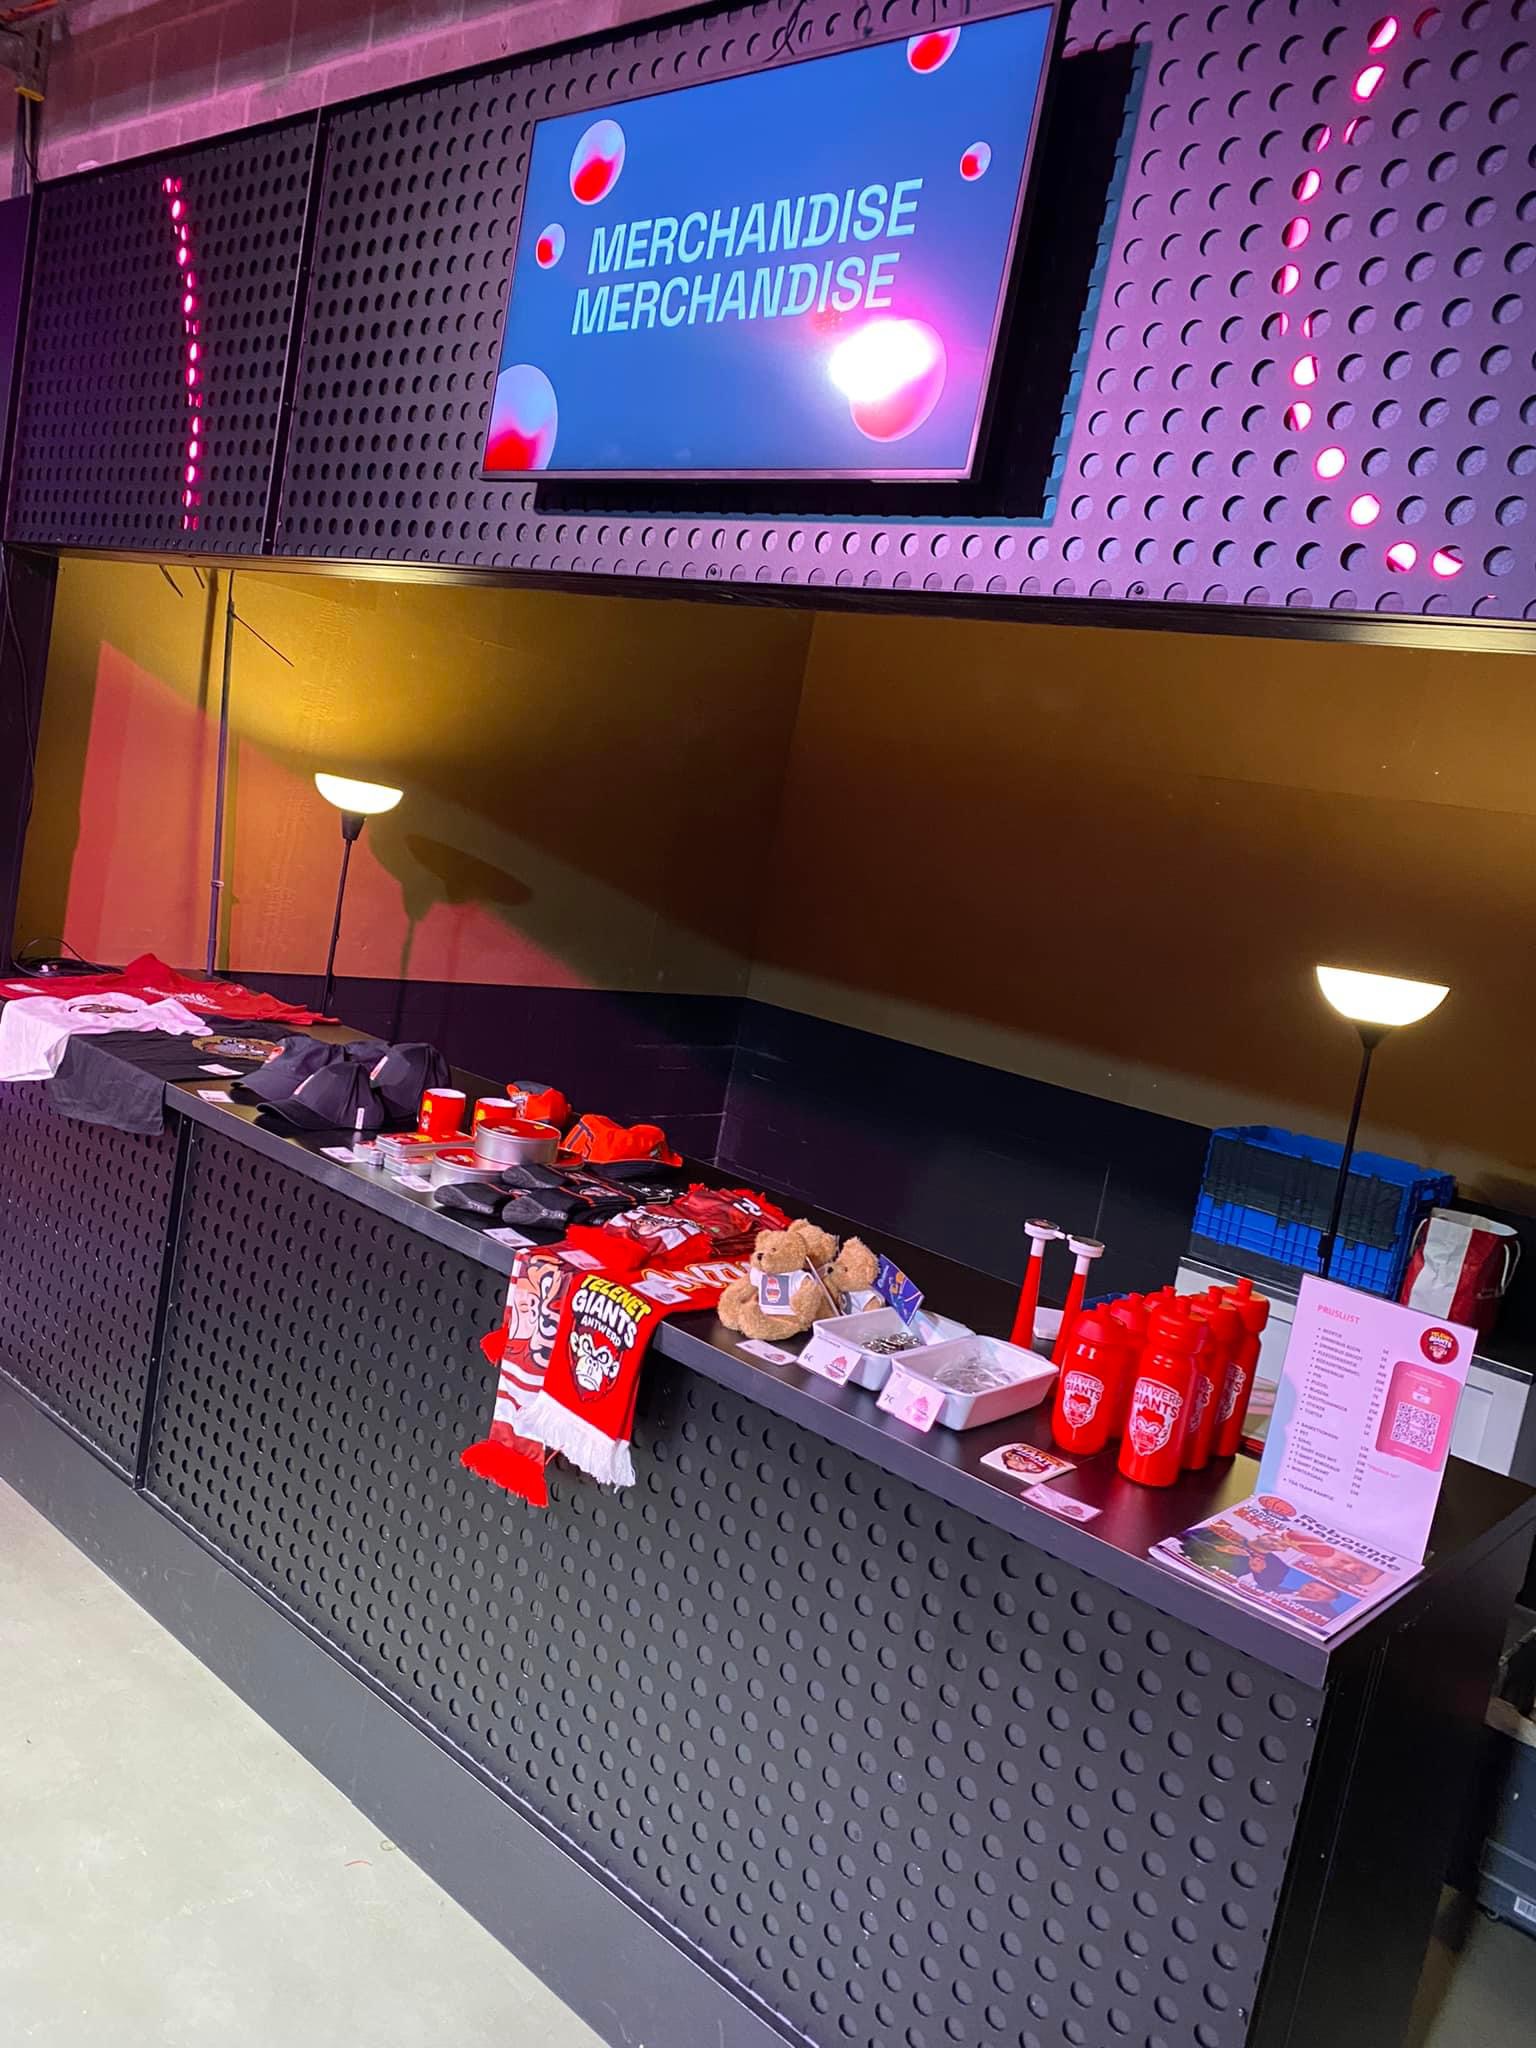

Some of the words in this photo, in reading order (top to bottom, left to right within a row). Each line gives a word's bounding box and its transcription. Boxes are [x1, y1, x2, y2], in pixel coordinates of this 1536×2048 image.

[587, 178, 923, 275] MERCHANDISE
[571, 252, 900, 336] MERCHANDISE
[572, 1288, 637, 1349] GIANTS
[580, 1274, 652, 1323] TELENET
[580, 1315, 622, 1347] ANTWERP
[1294, 1518, 1401, 1571] magazine
[1300, 1513, 1398, 1562] Rebound
